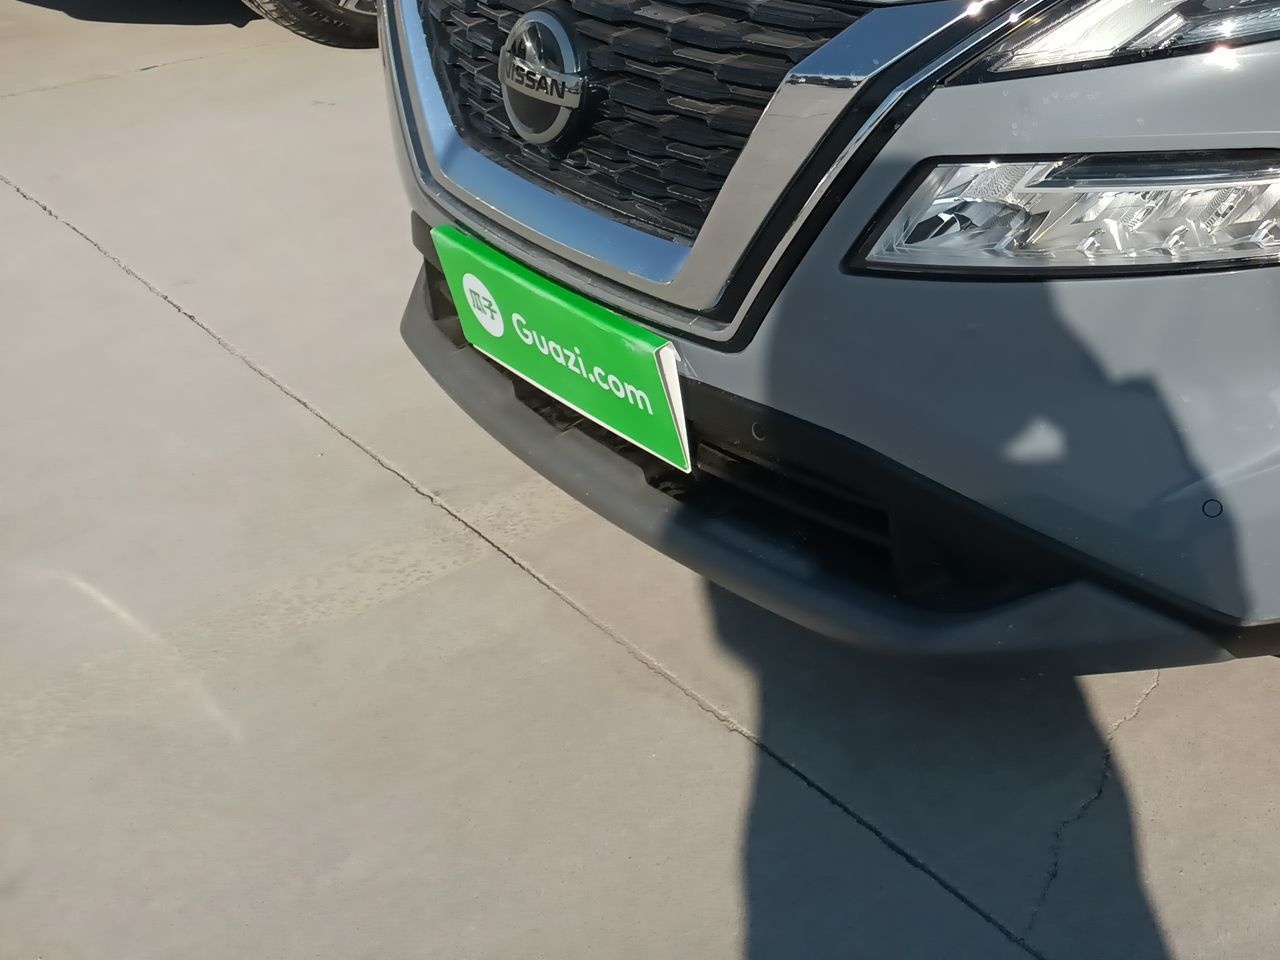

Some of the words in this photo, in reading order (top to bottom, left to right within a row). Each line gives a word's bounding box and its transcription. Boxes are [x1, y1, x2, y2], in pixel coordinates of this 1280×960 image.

[505, 60, 567, 100] NISSAN
[469, 289, 498, 321] 瓜子
[511, 312, 654, 416] Guazi.com
